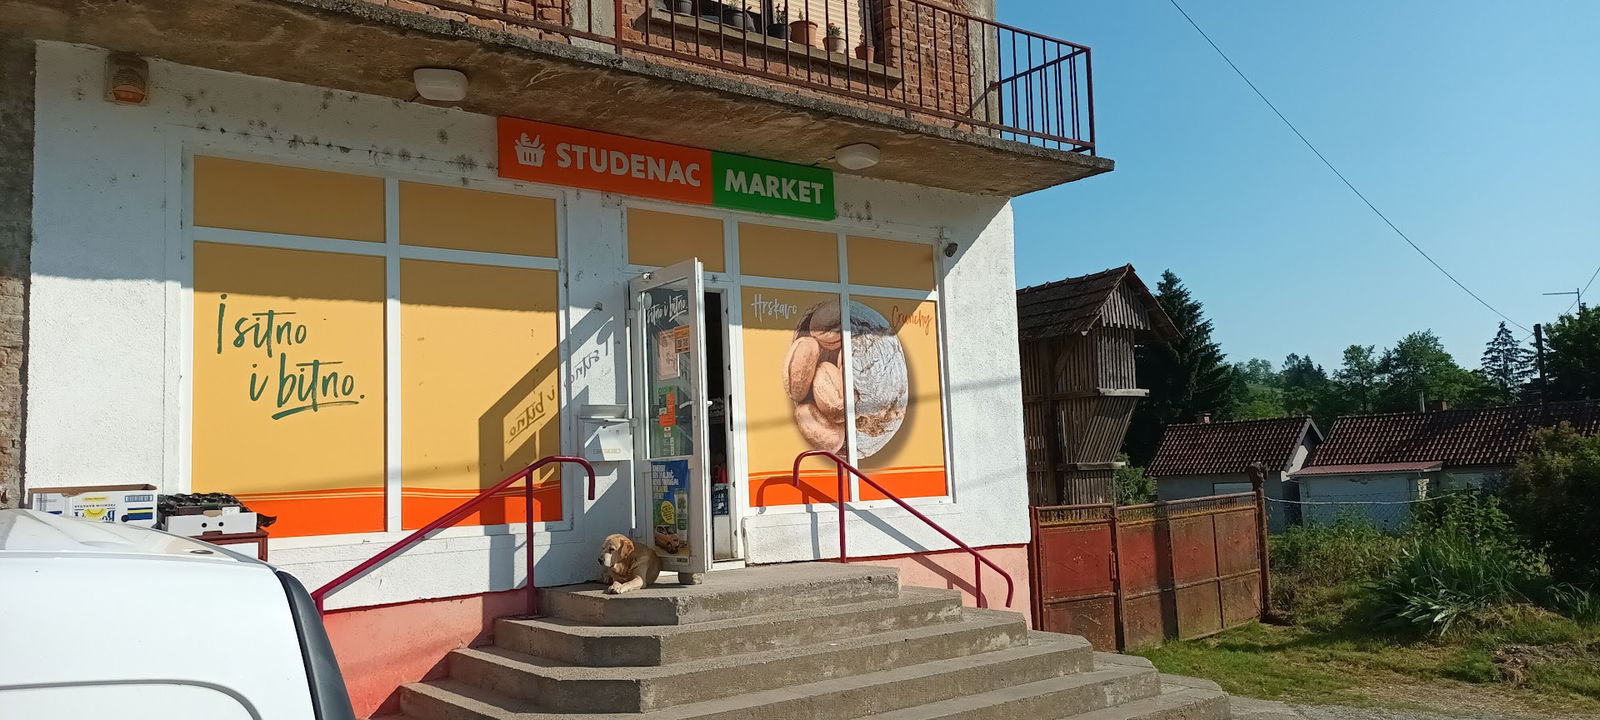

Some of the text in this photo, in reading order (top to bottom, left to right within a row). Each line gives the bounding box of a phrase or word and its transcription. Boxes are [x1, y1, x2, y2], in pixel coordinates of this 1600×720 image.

[556, 142, 825, 205] STUDENAC MARKET
[232, 309, 308, 359] sitno
[751, 293, 798, 322] Hrskavo
[249, 352, 366, 418] i bitno.
